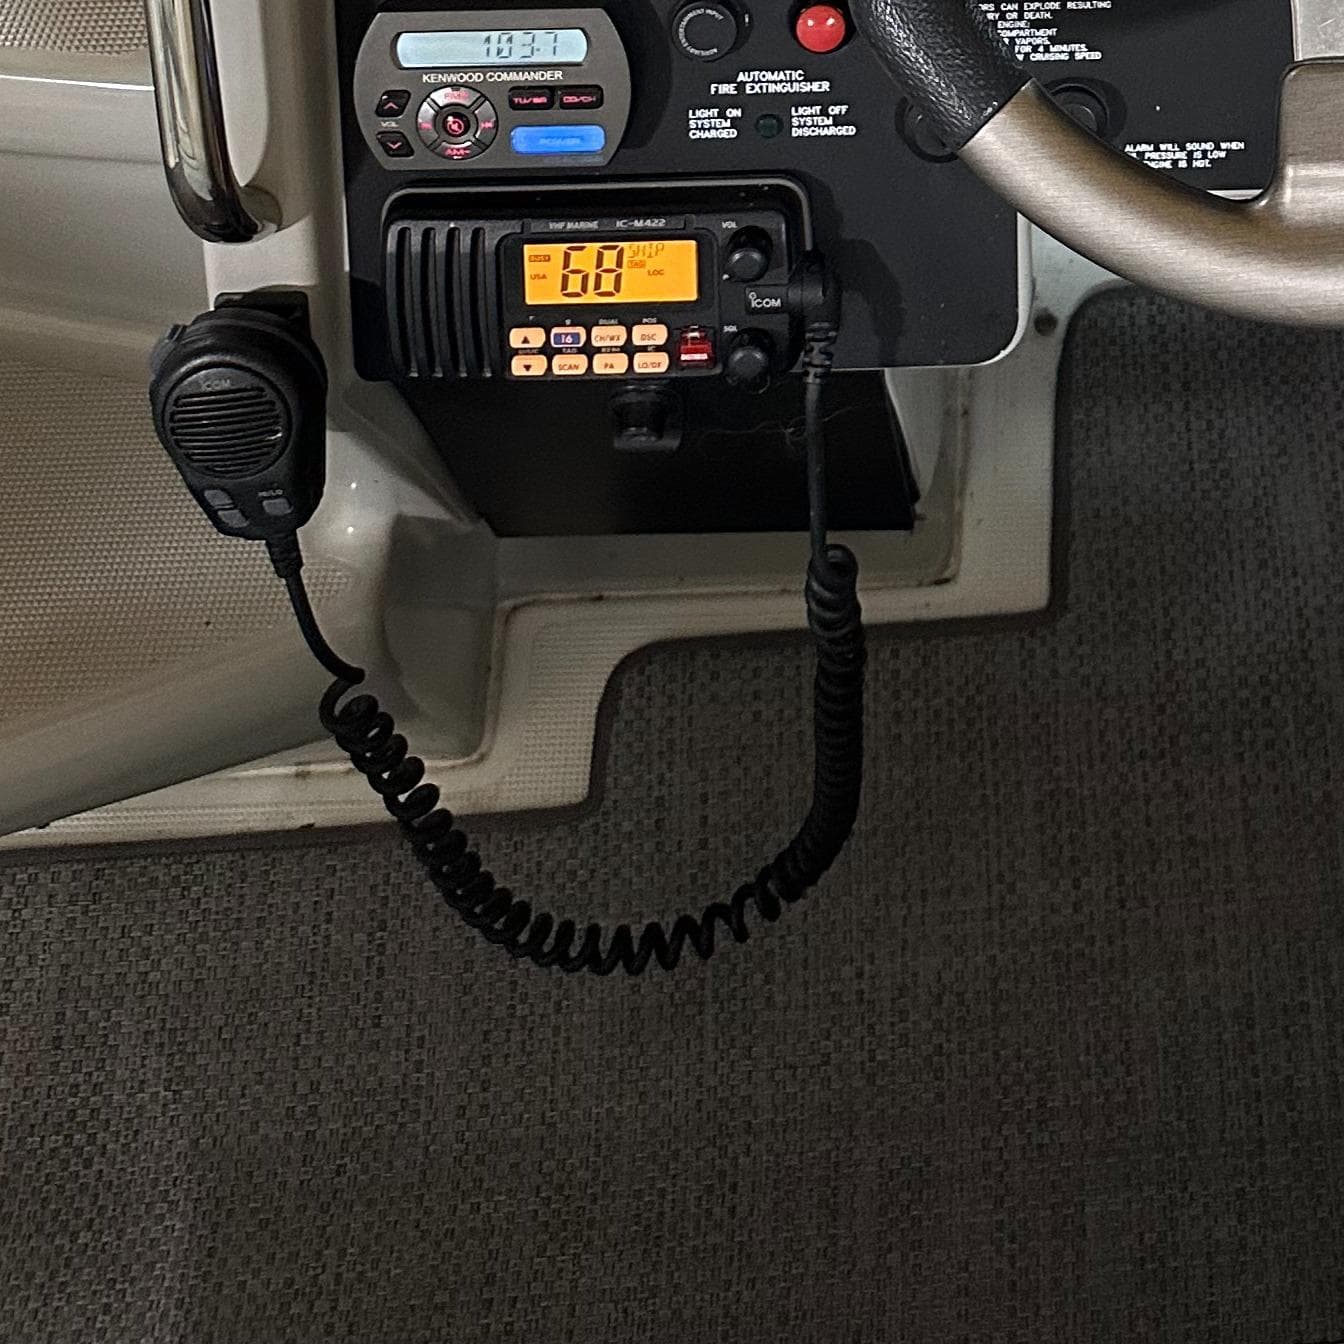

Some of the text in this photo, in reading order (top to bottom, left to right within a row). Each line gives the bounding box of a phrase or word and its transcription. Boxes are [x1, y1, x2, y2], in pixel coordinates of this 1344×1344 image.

[1000, 0, 1112, 11] CAN EXPLODE RESULTING
[1006, 12, 1018, 20] OR
[482, 31, 558, 58] 103.7
[1015, 45, 1032, 53] FOR
[1029, 52, 1070, 61] CRUISING
[1074, 51, 1102, 61] SPEED
[422, 70, 563, 84] KENWOOD COMMANDER
[737, 70, 805, 82] AUTOMATIC
[710, 81, 831, 95] FIRE EXTINGUISHER
[689, 108, 742, 119] LIGHT ON
[791, 105, 849, 116] LIGHT OFF
[381, 120, 399, 128] VOL
[689, 118, 731, 129] SYSTEM
[791, 116, 833, 127] SYSTEM
[688, 128, 738, 140] CHARGED
[791, 125, 857, 138] DISCHARGED
[1124, 141, 1245, 153] ALARM WILL SOUND WHEN
[1144, 151, 1188, 160] PRESSURE
[1193, 150, 1203, 159] IS
[1207, 150, 1227, 159] LOW
[1178, 159, 1188, 168] IS
[566, 219, 599, 230] MARINE
[616, 218, 666, 228] IC-M422
[722, 221, 738, 229] VOL
[628, 243, 664, 258] SHIP
[560, 244, 624, 298] 68
[530, 273, 548, 281] USA
[560, 333, 573, 343] 16
[640, 333, 657, 342] DSC
[558, 363, 580, 371] SCAN
